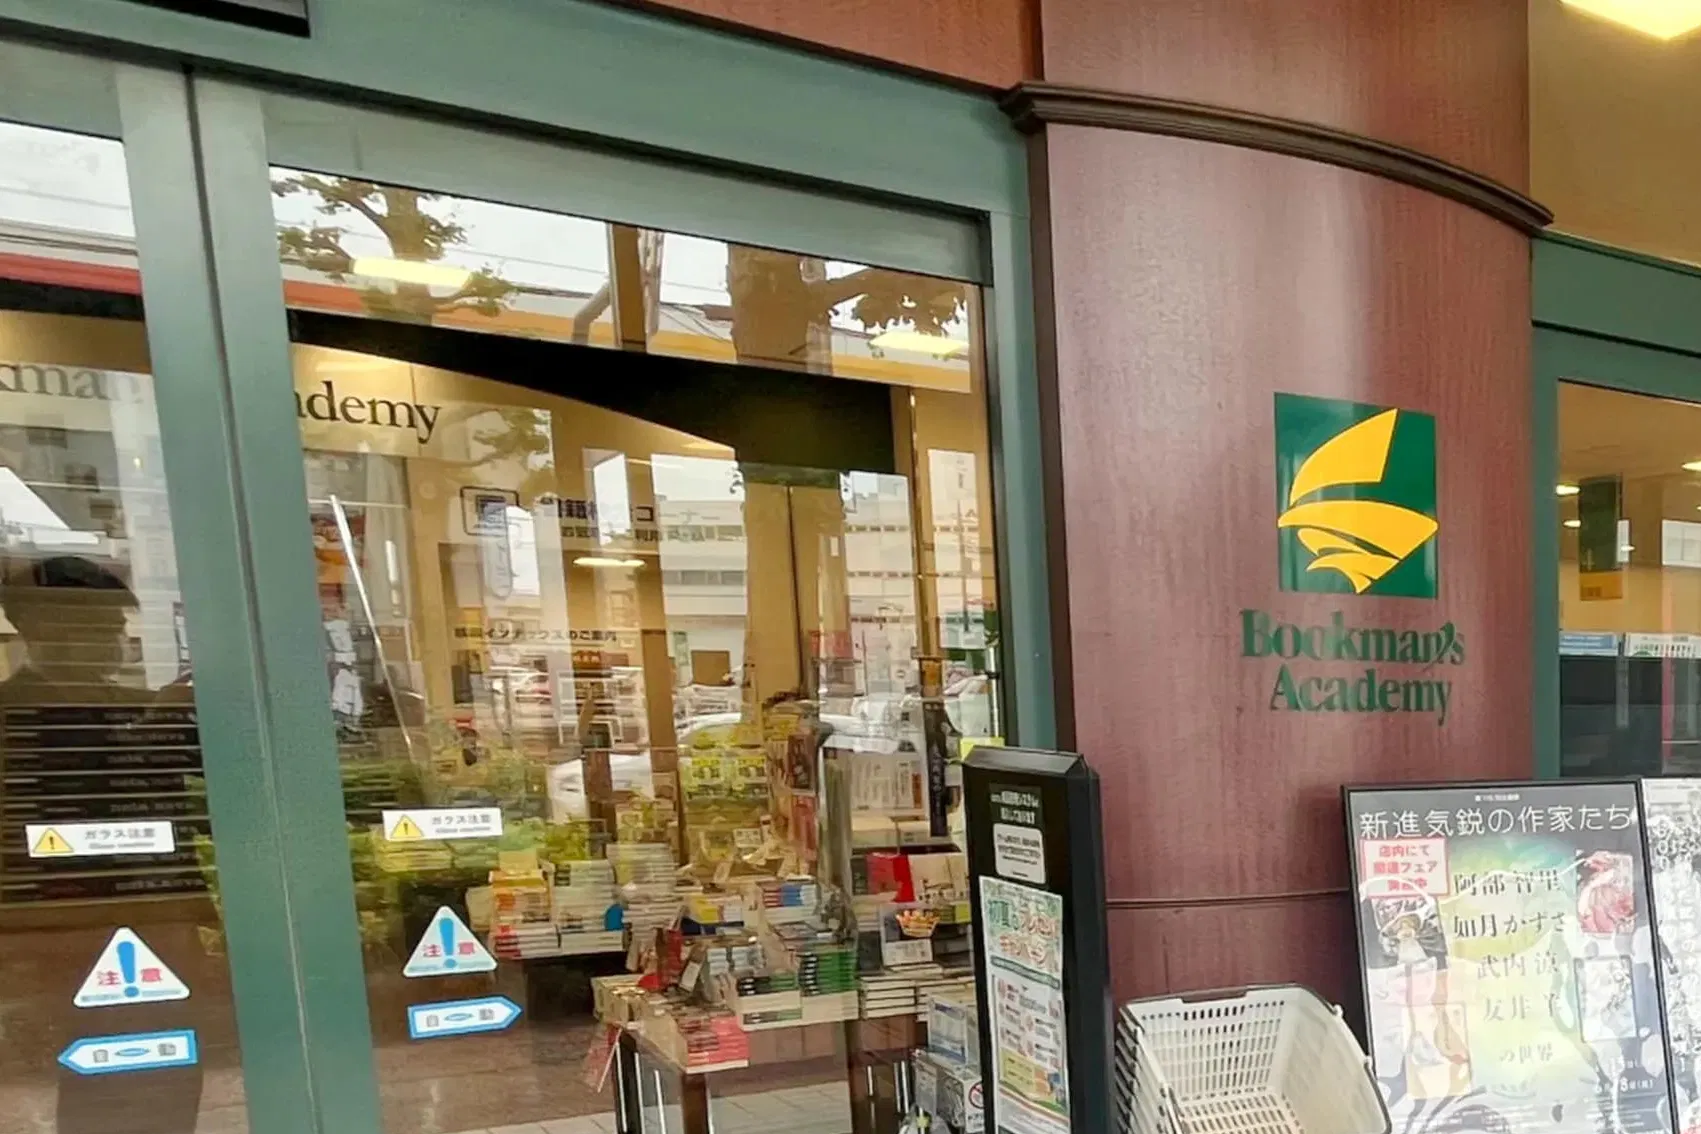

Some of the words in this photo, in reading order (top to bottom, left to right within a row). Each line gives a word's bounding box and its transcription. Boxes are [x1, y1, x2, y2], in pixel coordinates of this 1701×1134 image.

[1239, 608, 1466, 668] Bookman's
[1269, 663, 1452, 727] Academy
[1359, 804, 1632, 840] 新進気鋭の作家たち
[1454, 911, 1565, 938] 如月かずさ
